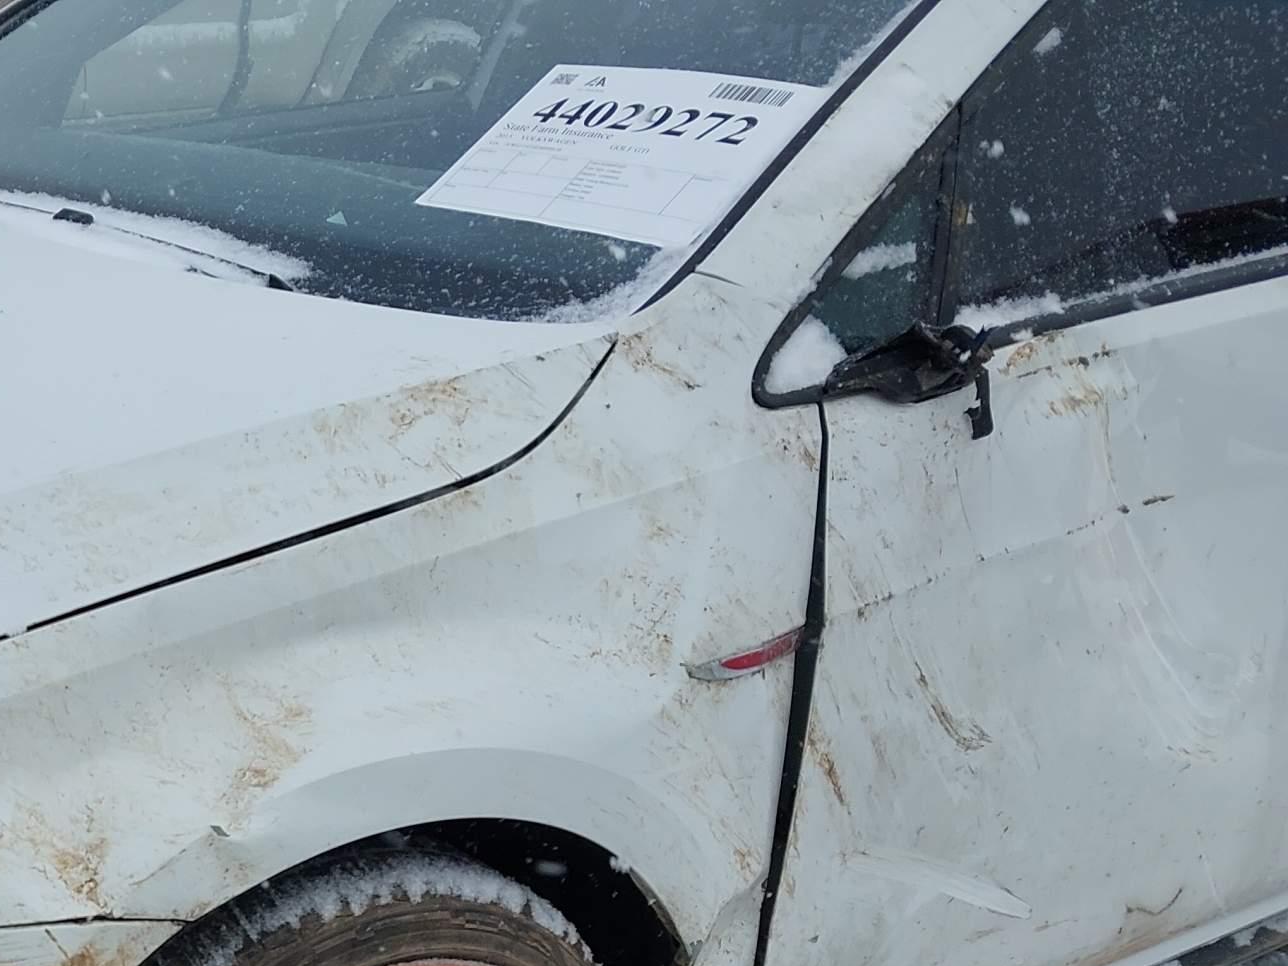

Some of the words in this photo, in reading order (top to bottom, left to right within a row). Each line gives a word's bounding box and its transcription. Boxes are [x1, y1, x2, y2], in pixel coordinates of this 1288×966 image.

[503, 122, 530, 133] State
[531, 124, 560, 136] Farm
[561, 127, 614, 142] Insurance
[533, 97, 759, 146] 44029272
